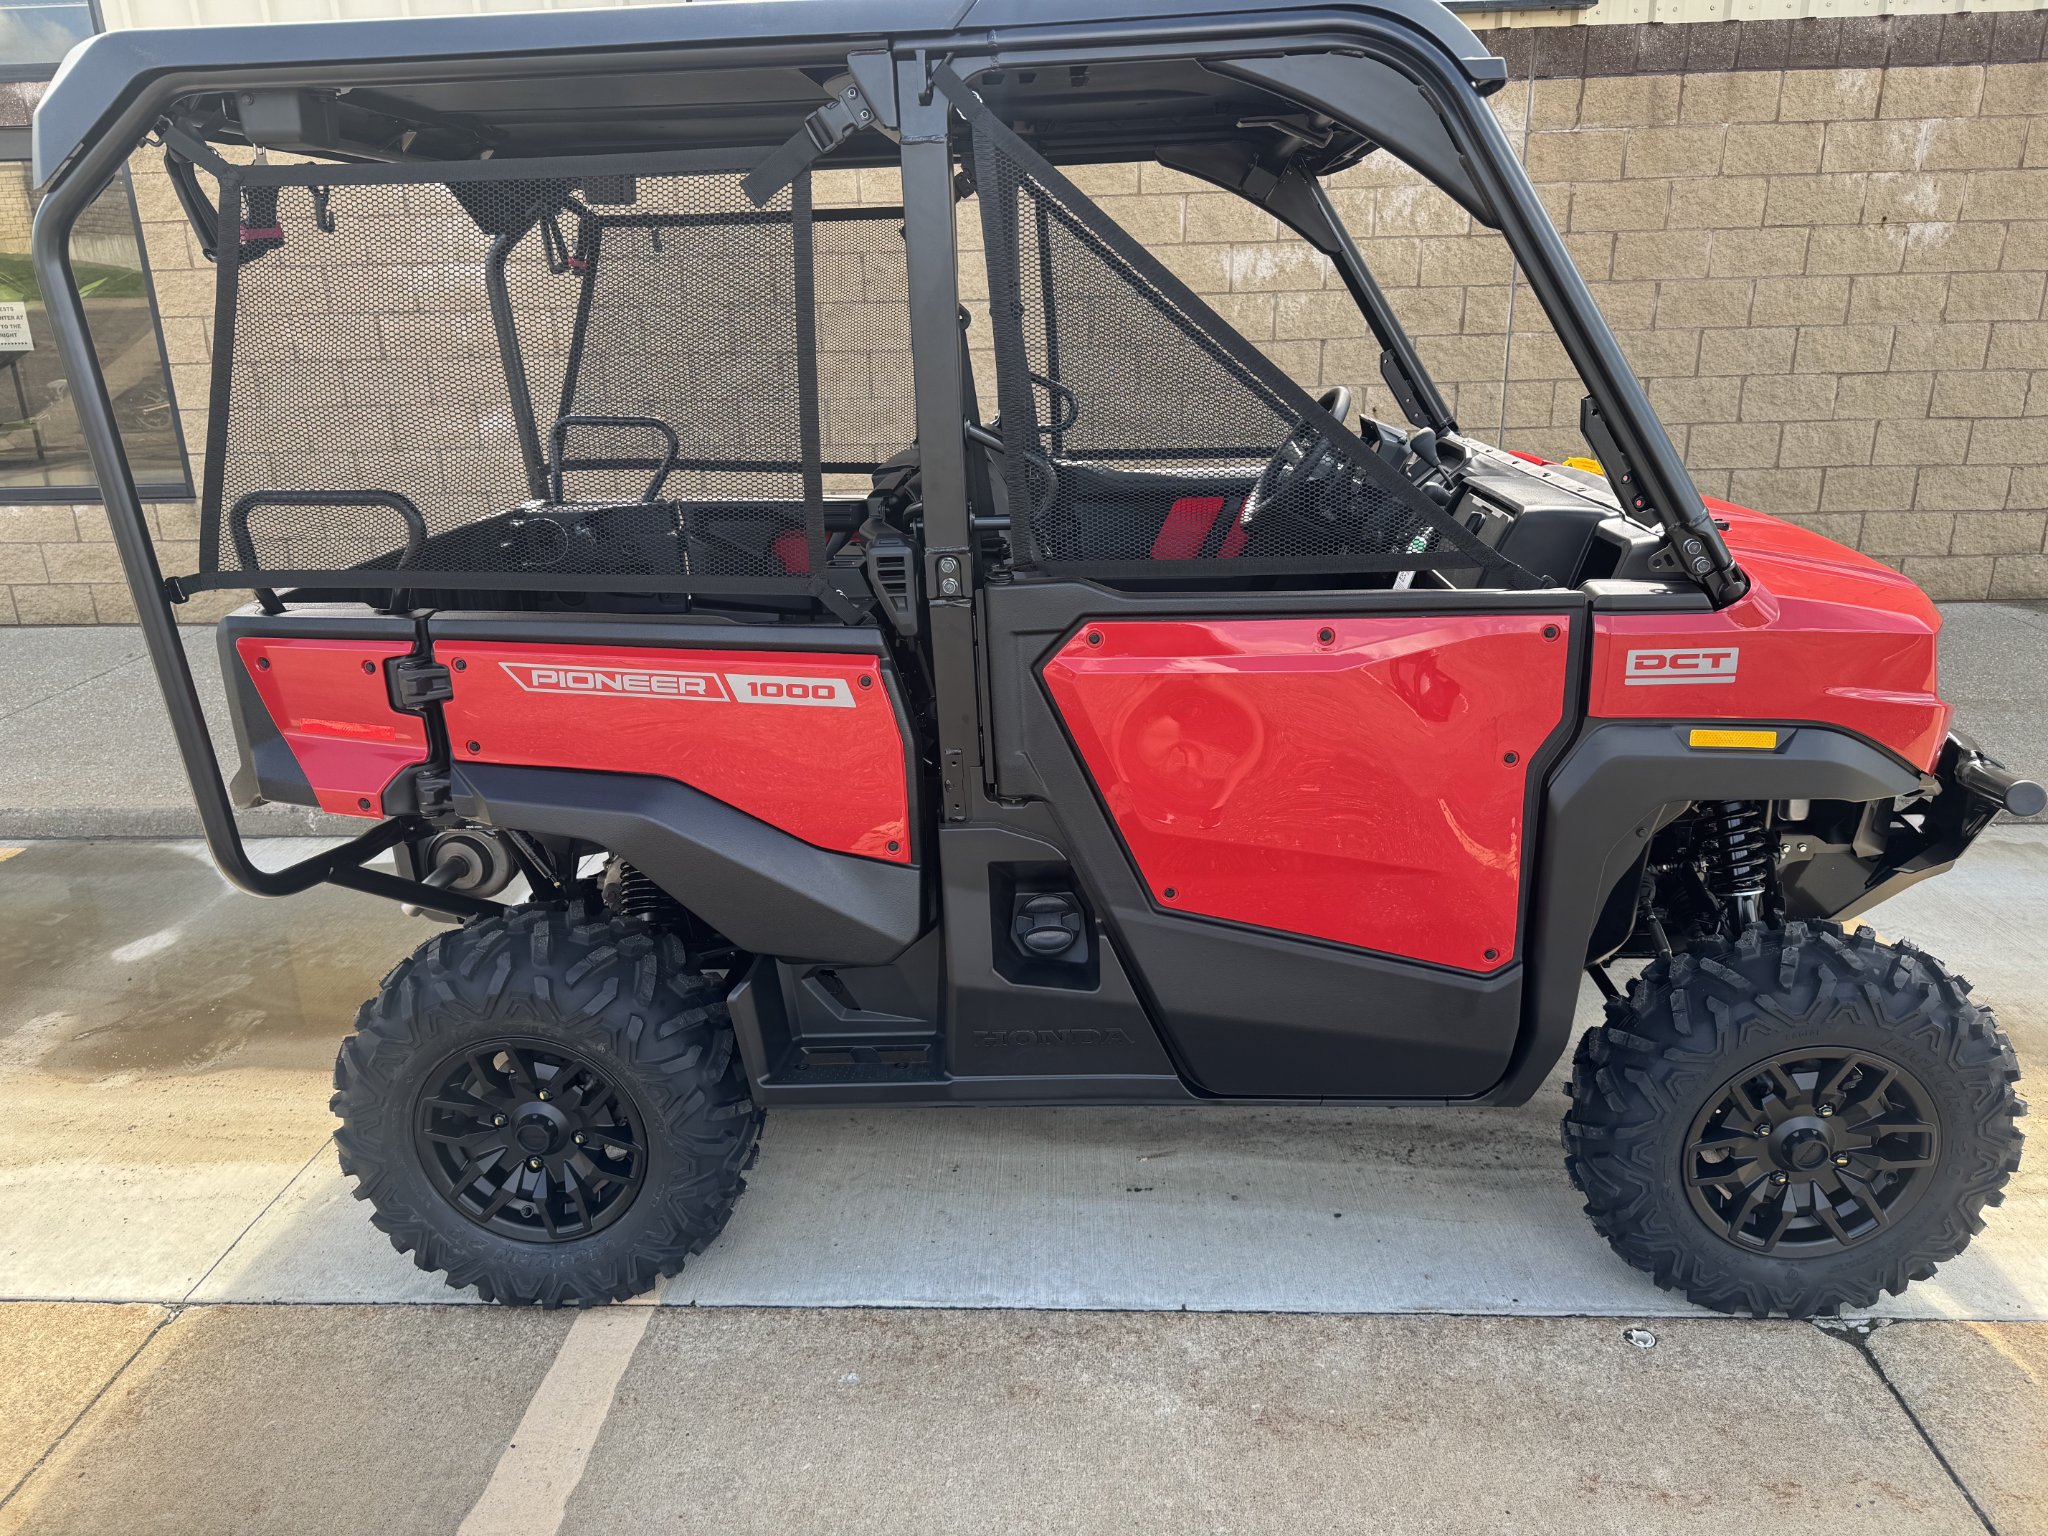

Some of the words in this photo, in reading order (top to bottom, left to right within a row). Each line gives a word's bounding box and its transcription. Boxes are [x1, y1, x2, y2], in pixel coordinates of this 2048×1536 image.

[1634, 652, 1731, 671] DCT
[530, 668, 706, 695] PIONEER
[746, 681, 836, 700] 1000
[972, 1027, 1136, 1047] HONDA
